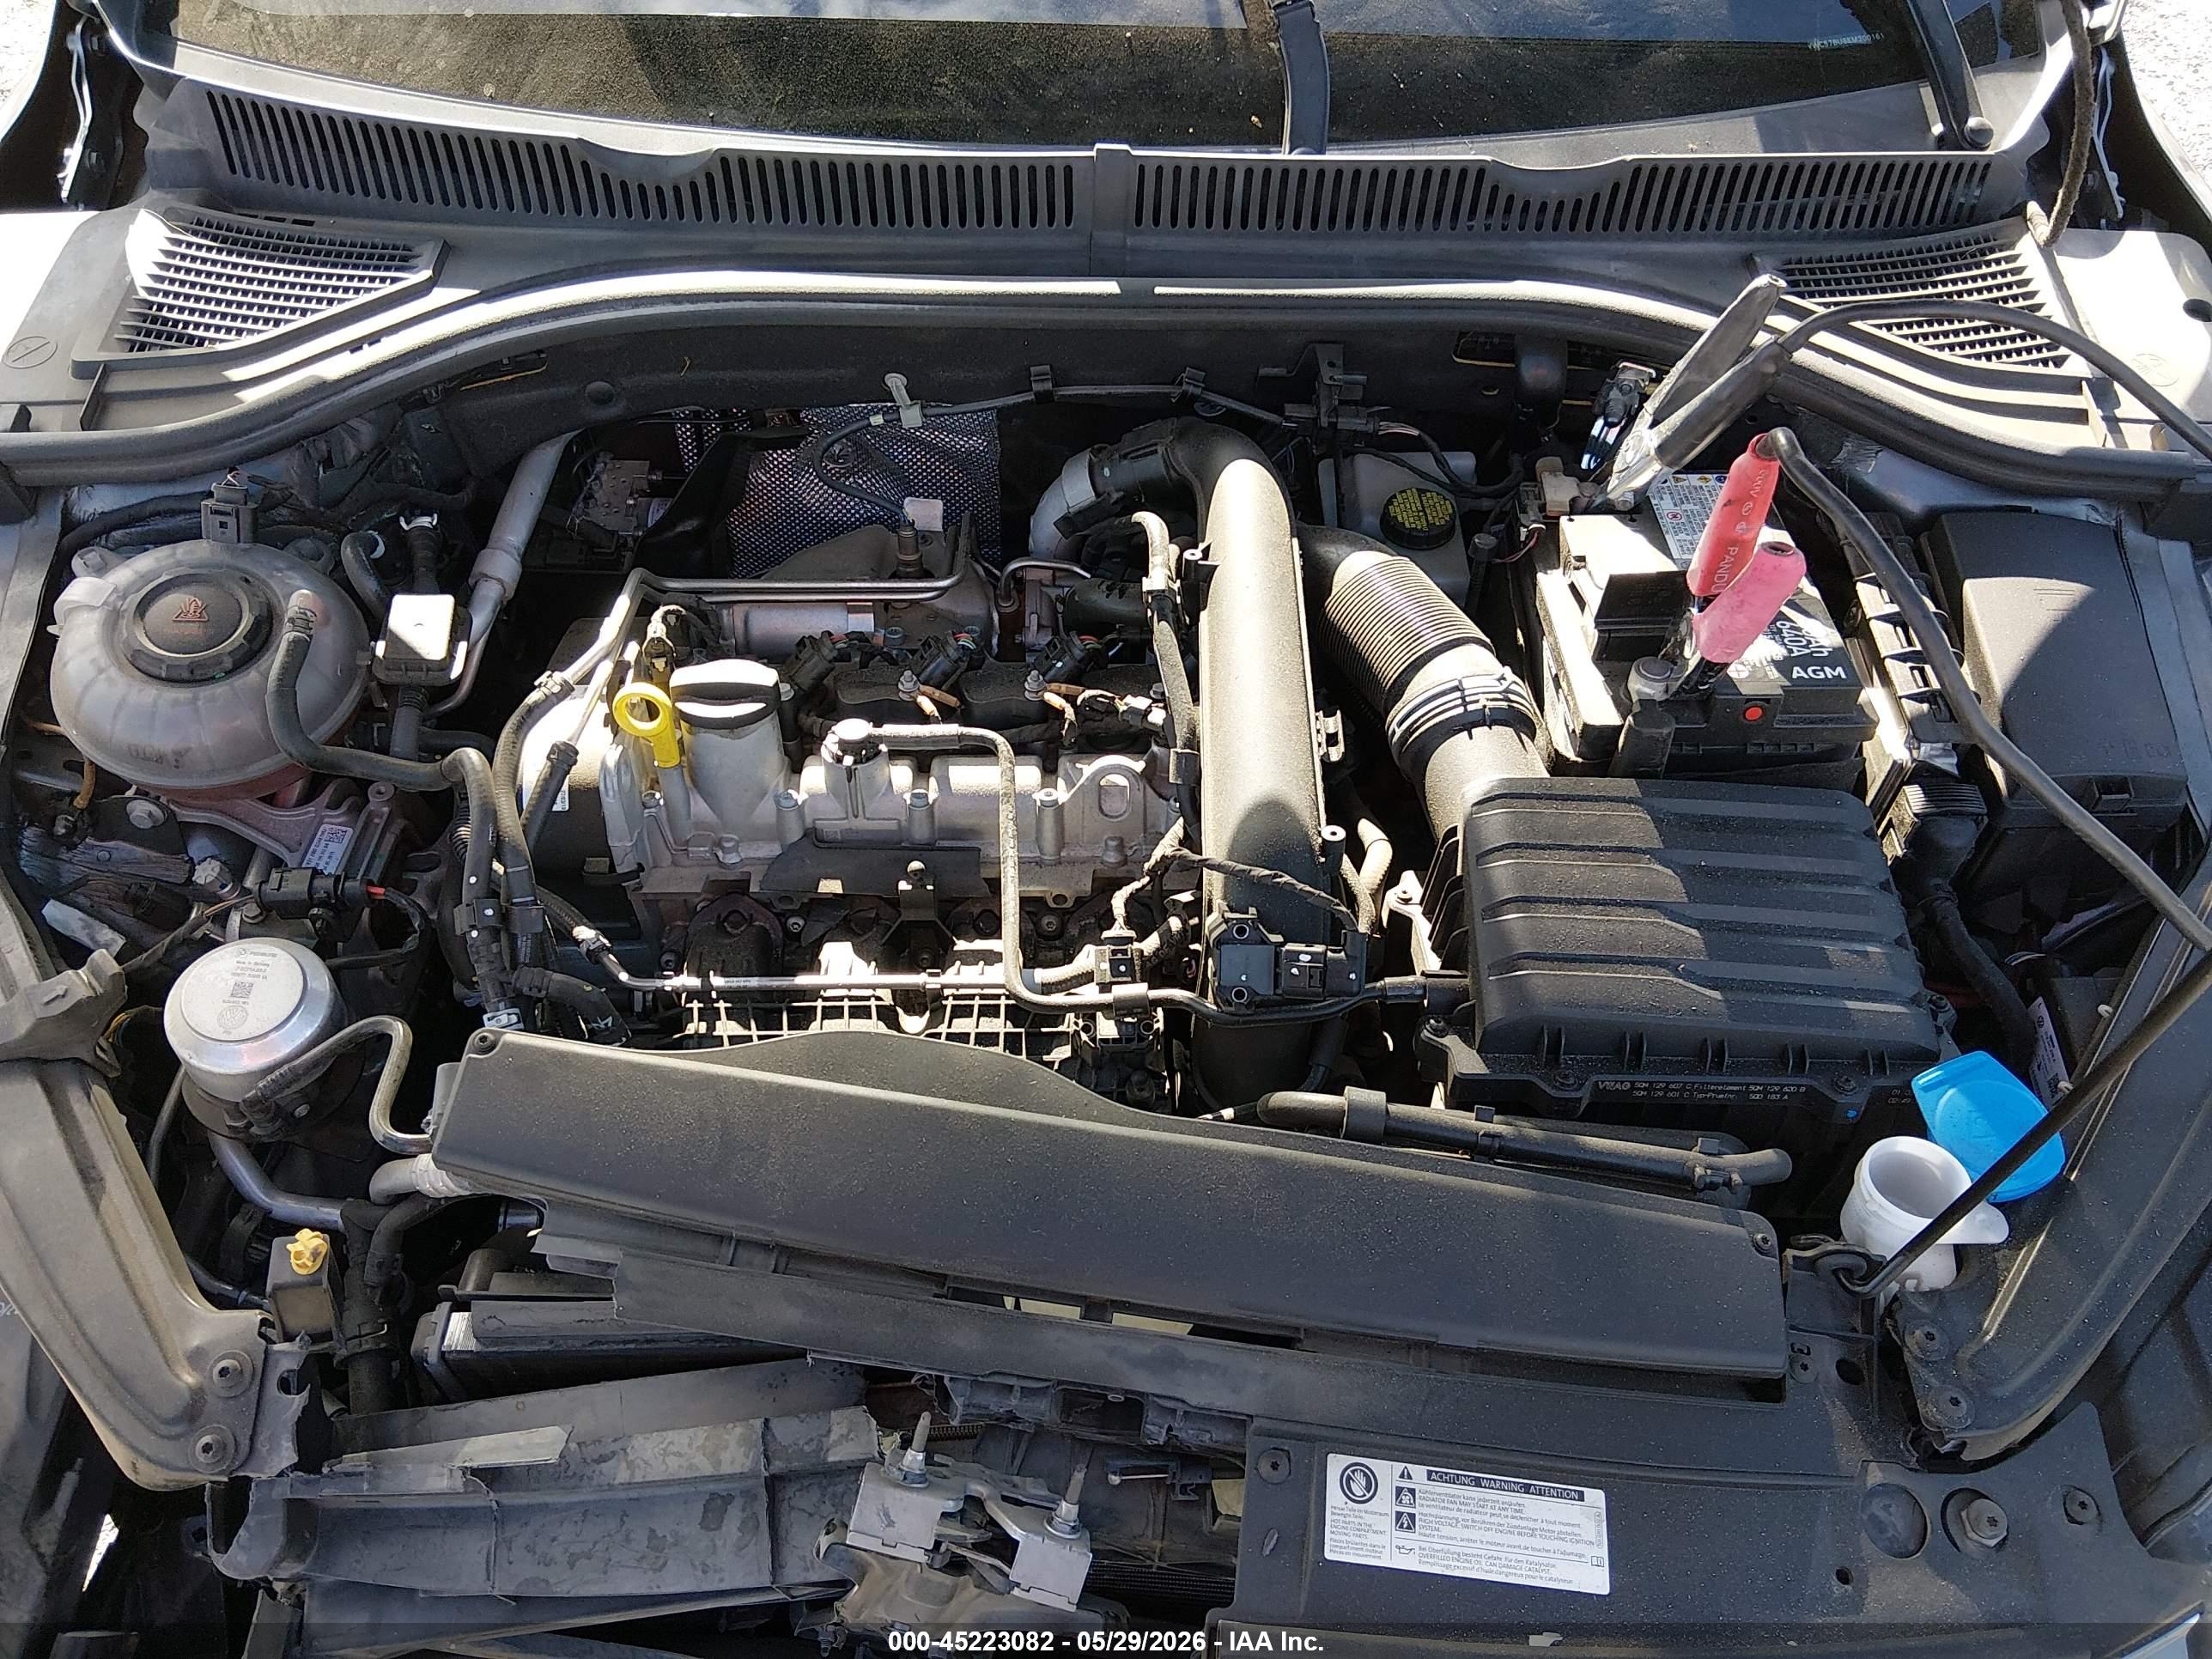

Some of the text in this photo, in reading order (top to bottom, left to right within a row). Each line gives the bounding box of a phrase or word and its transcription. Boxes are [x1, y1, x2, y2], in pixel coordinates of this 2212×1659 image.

[1776, 620, 1812, 658] 640A
[1791, 665, 1847, 679] AGM
[1430, 1471, 1577, 1499] ACHTUNG WARNING ATTENTION
